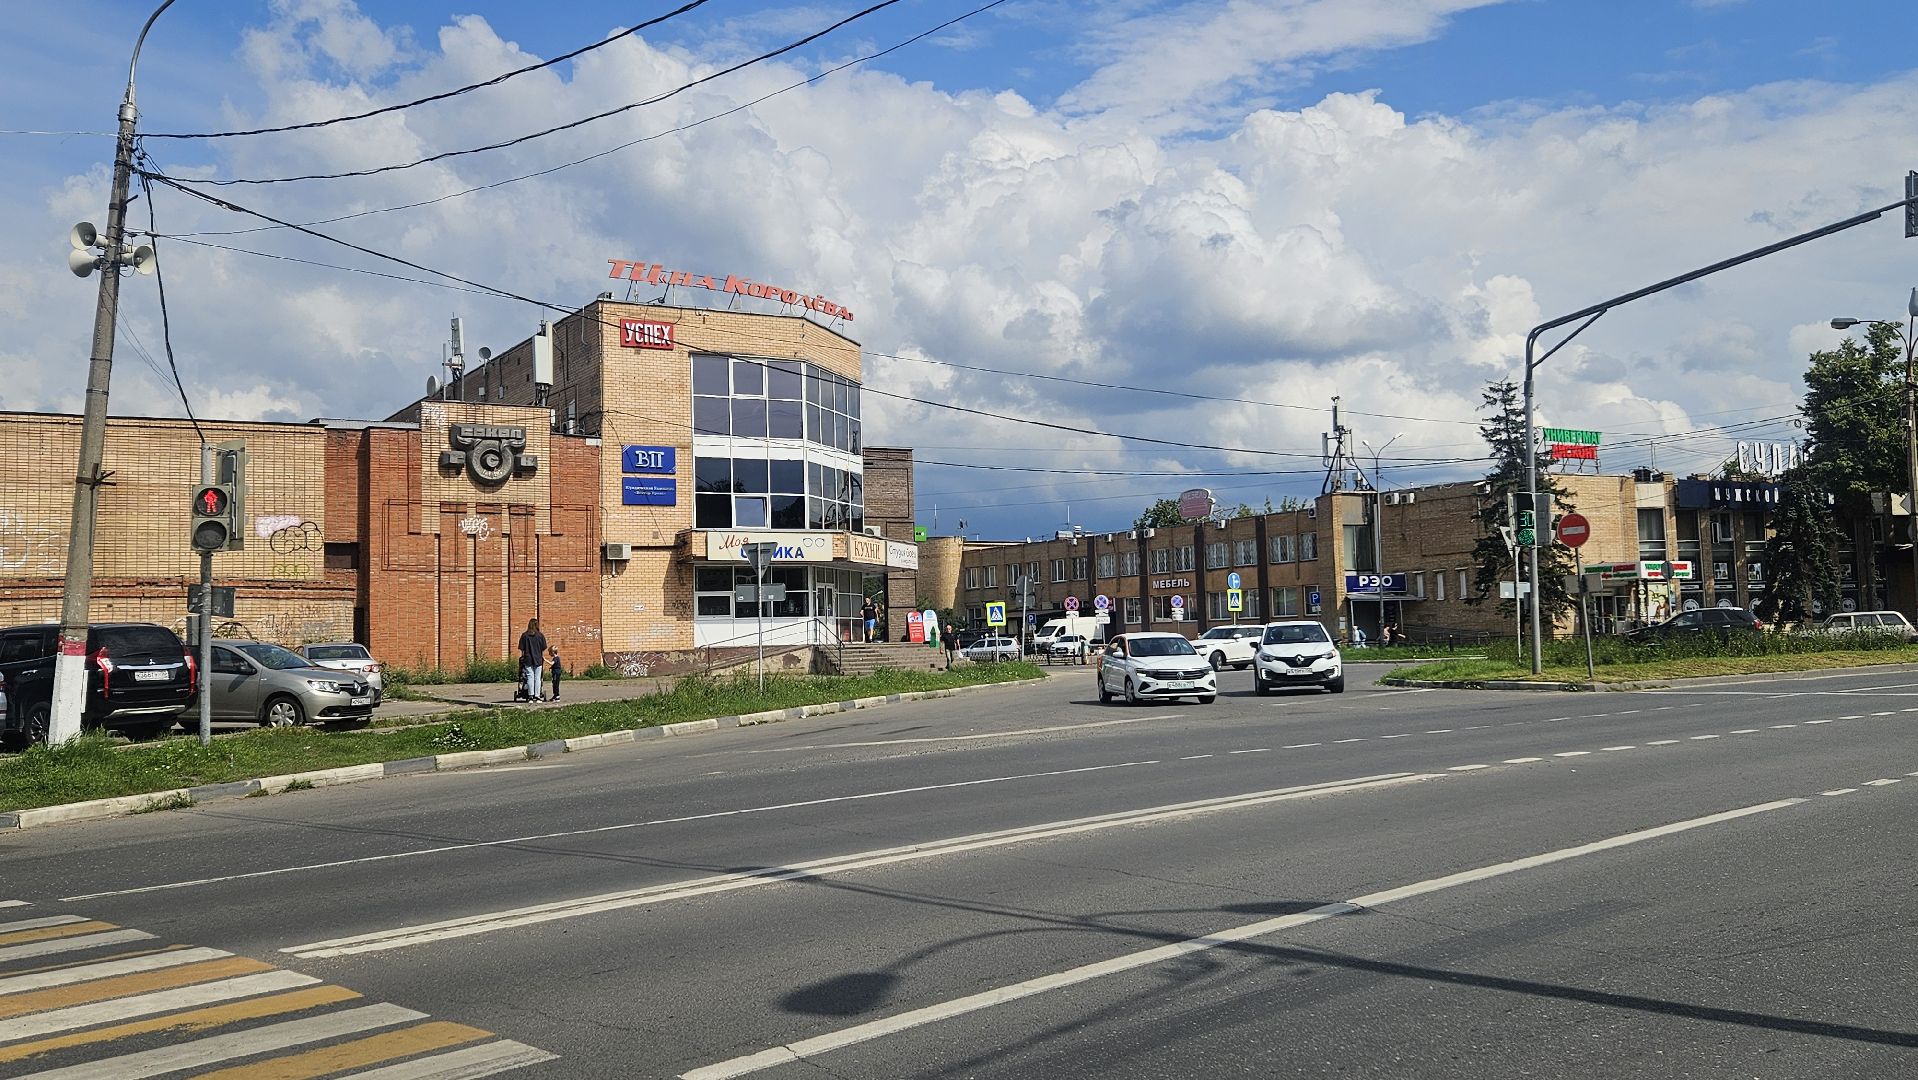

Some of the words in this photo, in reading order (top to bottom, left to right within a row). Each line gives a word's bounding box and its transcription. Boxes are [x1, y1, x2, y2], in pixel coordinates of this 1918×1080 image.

[624, 322, 672, 346] УСПЕХ
[460, 427, 523, 438] СОКОЛ
[1544, 429, 1601, 445] УНИВЕРМАГ
[635, 450, 665, 468] ВП
[719, 534, 750, 550] Моя
[854, 540, 881, 560] КУХНИ
[1153, 579, 1190, 589] МЕБЕЛЬ
[1358, 575, 1393, 587] РЭО
